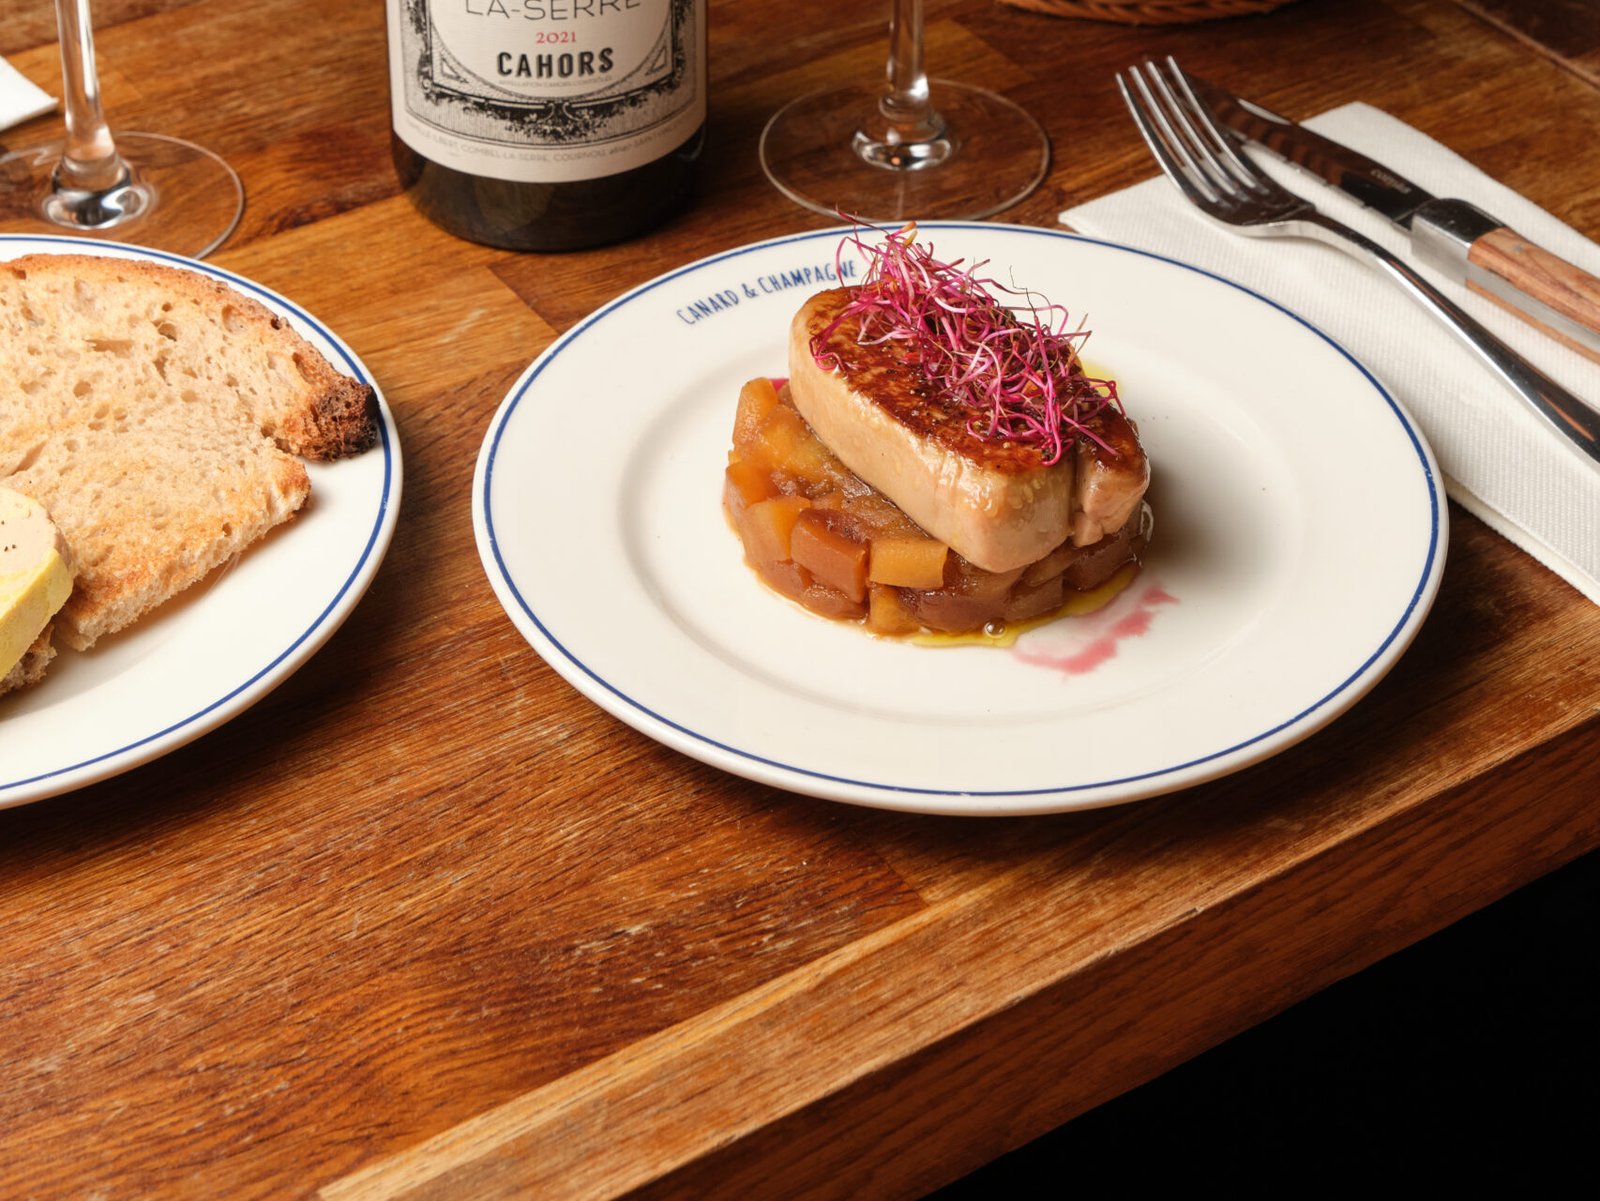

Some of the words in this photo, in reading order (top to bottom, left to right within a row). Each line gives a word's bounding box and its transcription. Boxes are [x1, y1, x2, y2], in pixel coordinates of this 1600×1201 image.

[535, 31, 577, 44] 2021
[496, 47, 614, 79] CAHORS
[676, 289, 740, 325] CANARD
[741, 283, 759, 298] &
[757, 260, 857, 294] CHAMPAGNE
